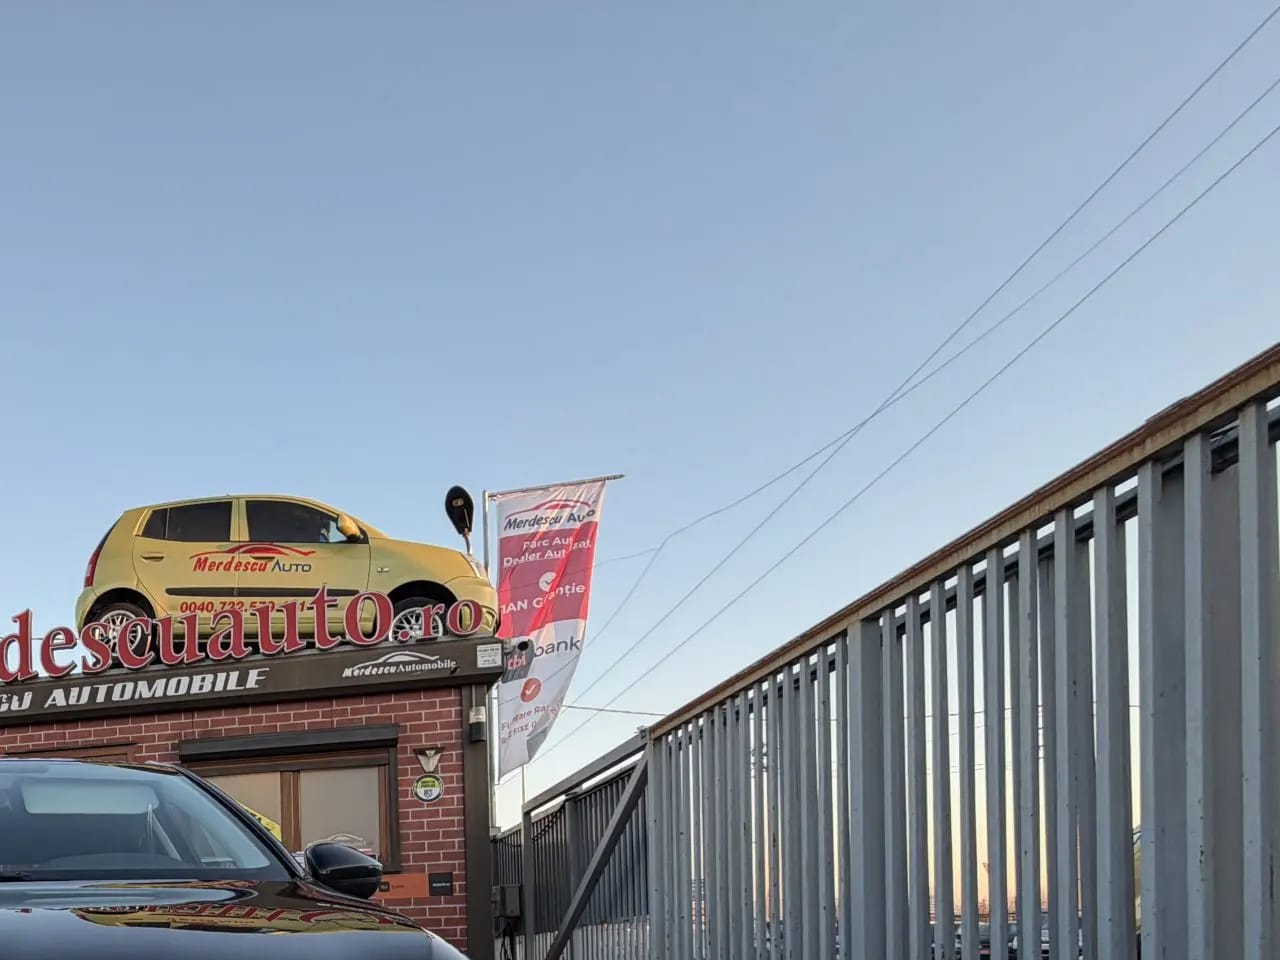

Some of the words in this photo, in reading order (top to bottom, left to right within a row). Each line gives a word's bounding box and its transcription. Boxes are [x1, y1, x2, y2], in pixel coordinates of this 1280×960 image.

[504, 513, 563, 531] Merdescu
[567, 509, 596, 523] Auo
[523, 539, 549, 549] Parc
[193, 556, 269, 573] Merdescu
[271, 559, 312, 573] AUTO
[44, 668, 269, 709] AUTOMOBILE
